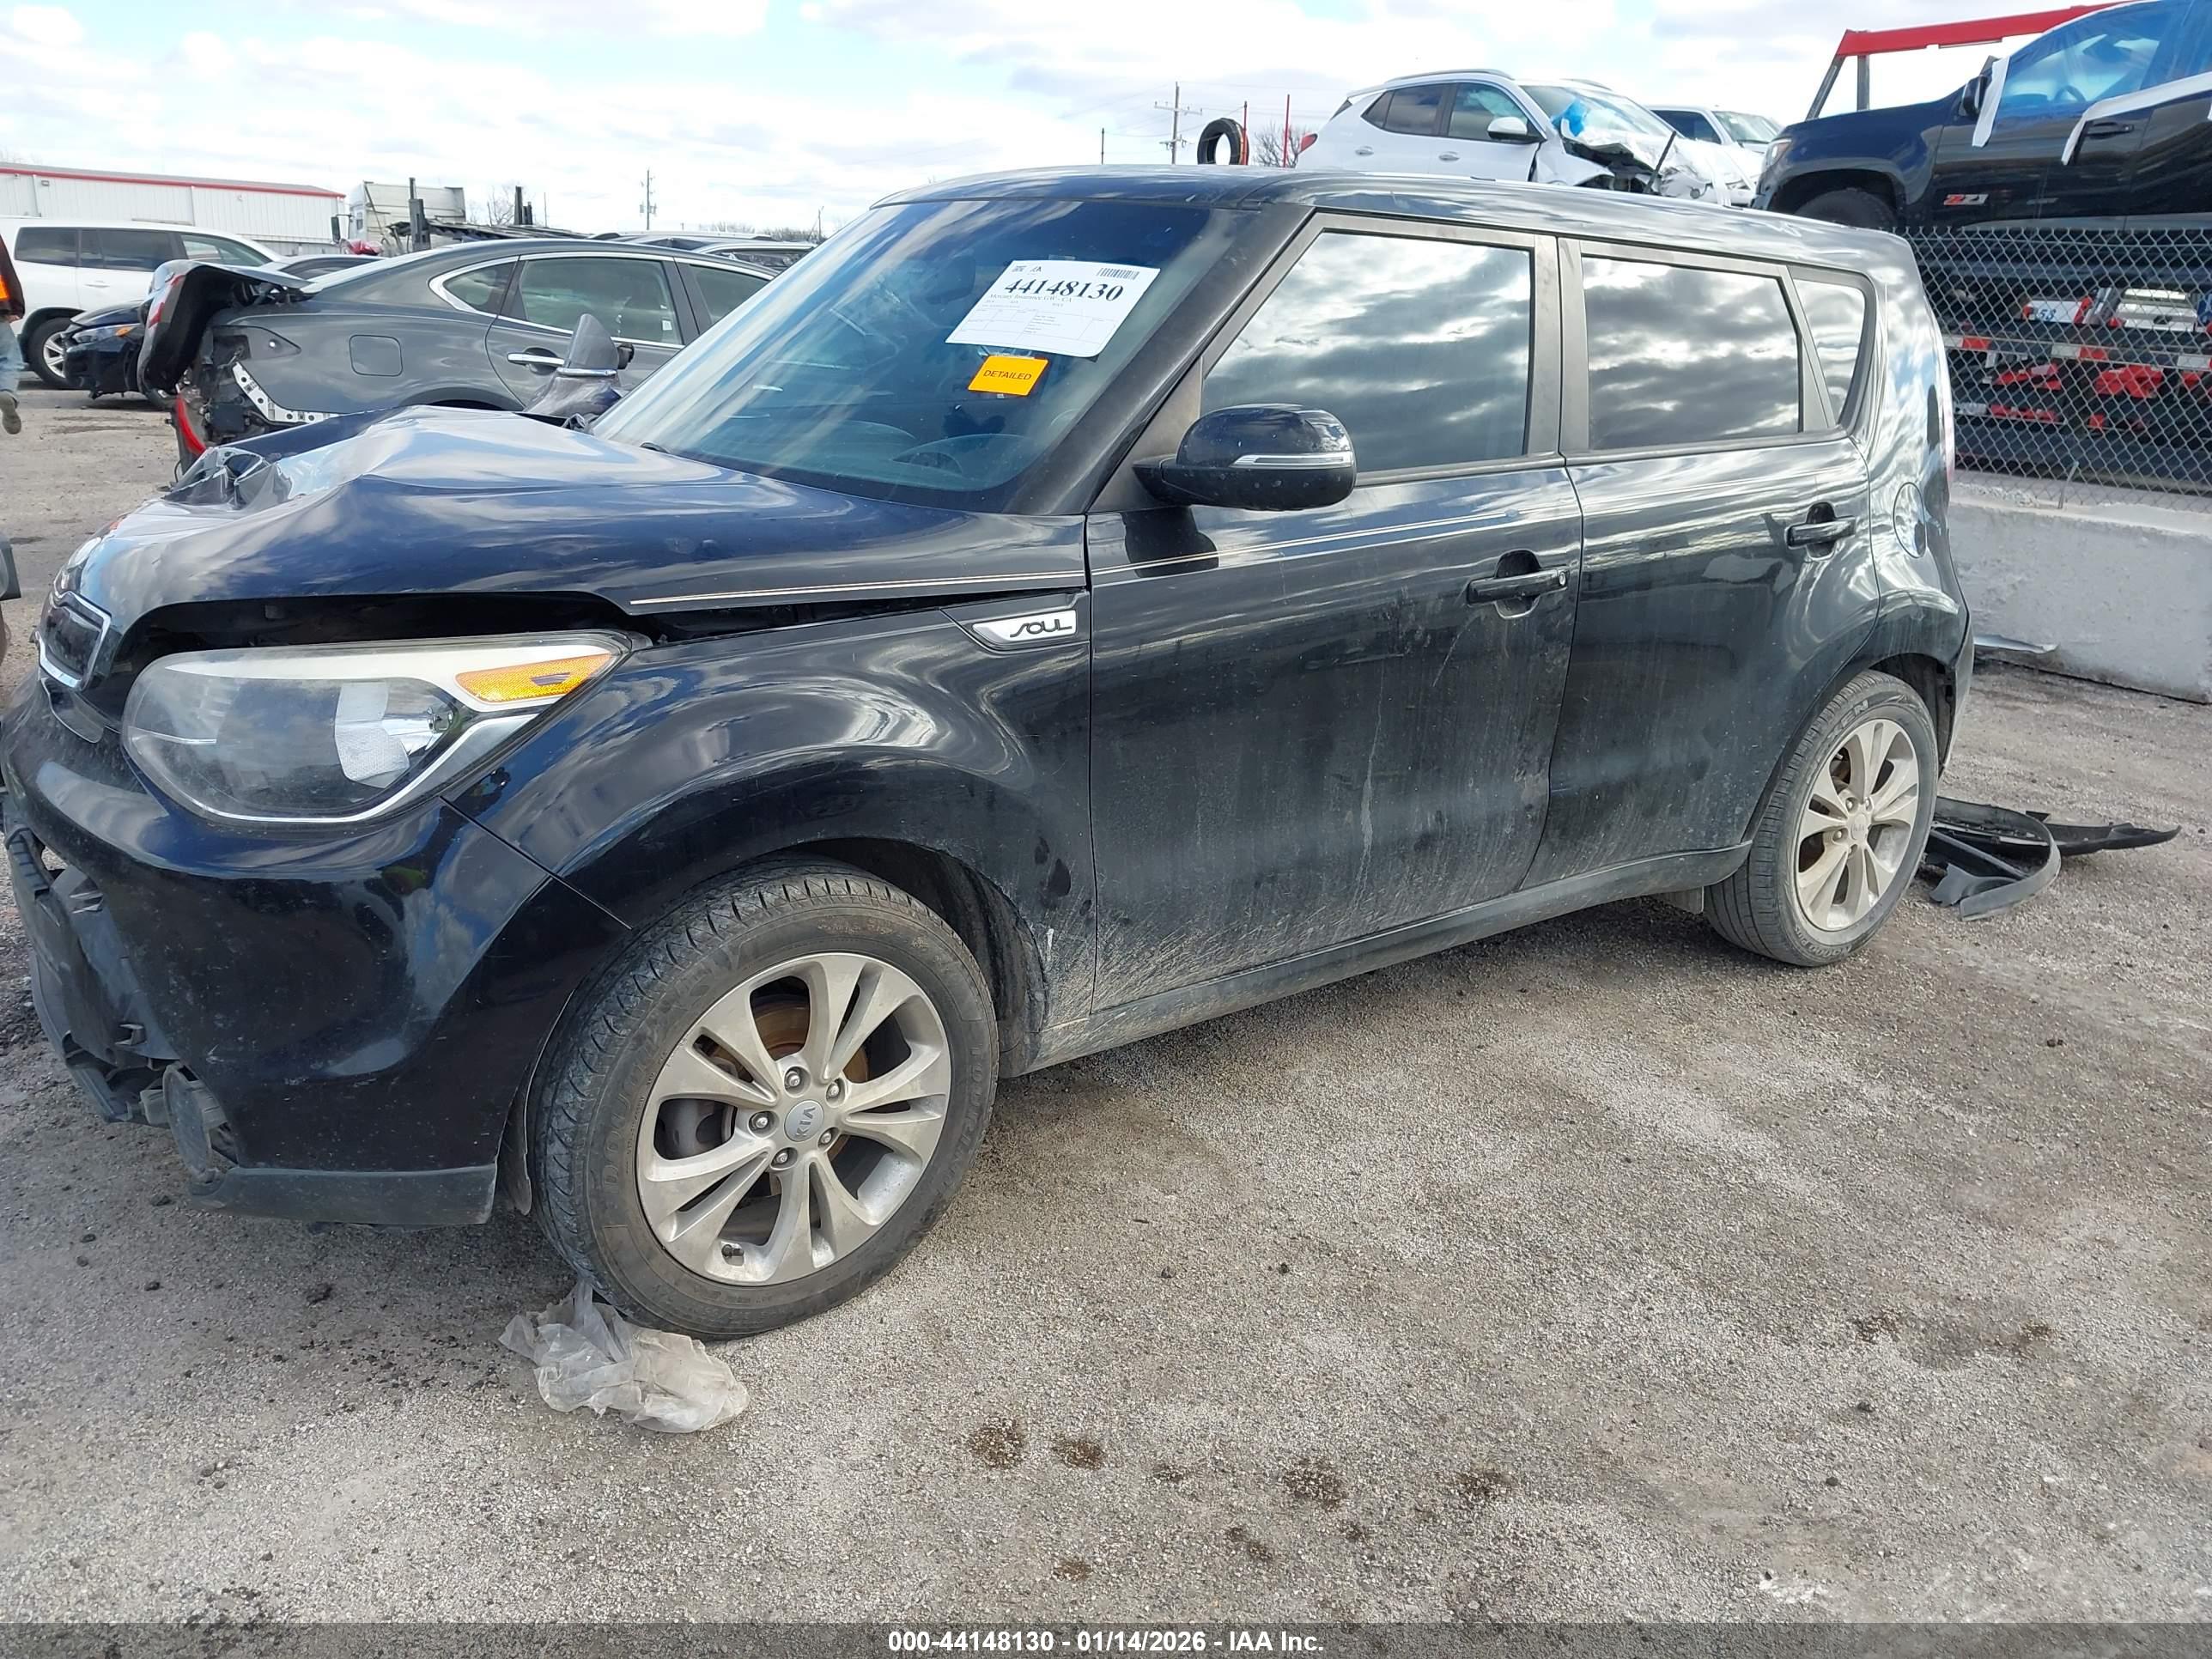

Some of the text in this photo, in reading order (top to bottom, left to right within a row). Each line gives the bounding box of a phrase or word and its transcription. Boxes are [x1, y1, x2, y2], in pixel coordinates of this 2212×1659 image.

[1944, 194, 1989, 206] Z71
[1004, 278, 1124, 301] 44148130
[983, 369, 1032, 380] DETAILED
[1009, 618, 1073, 638] SOUL
[795, 1105, 816, 1136] KIA
